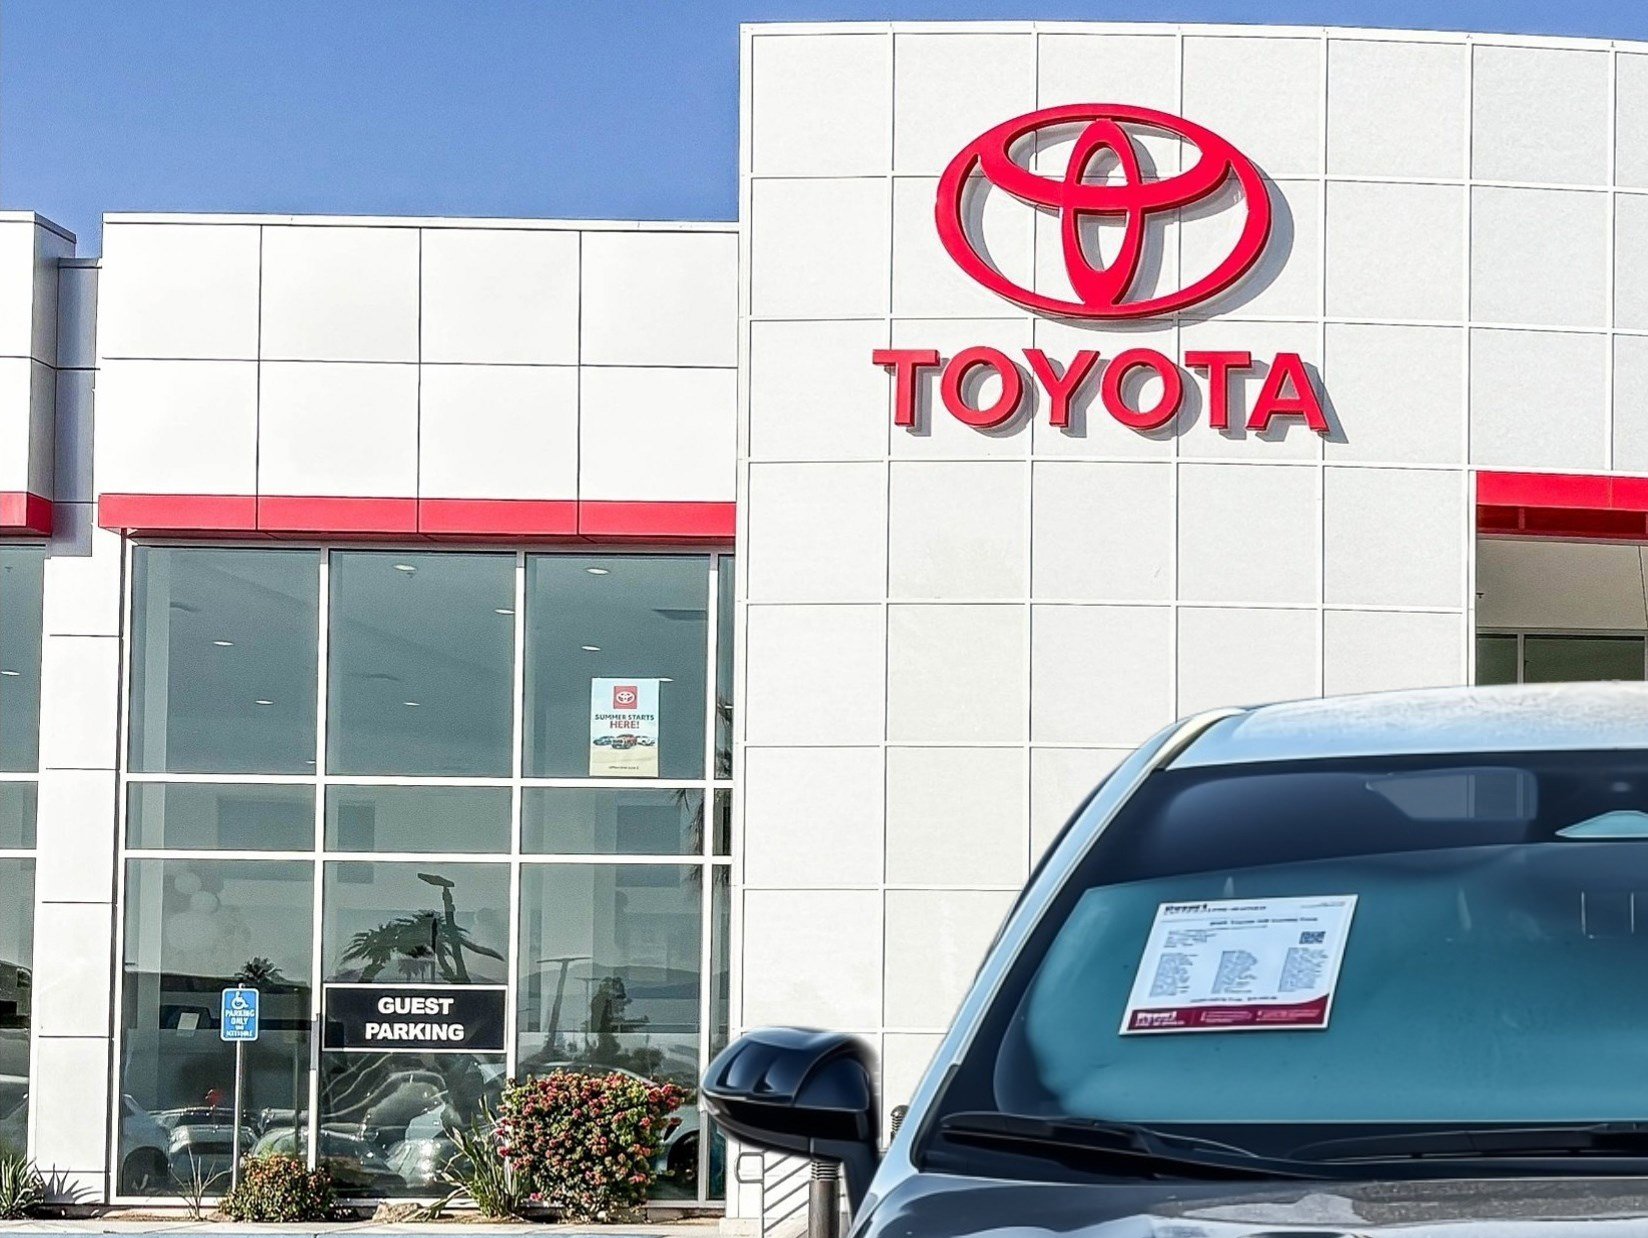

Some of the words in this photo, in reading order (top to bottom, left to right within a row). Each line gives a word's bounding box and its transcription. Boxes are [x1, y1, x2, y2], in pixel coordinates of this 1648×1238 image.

[872, 345, 1329, 433] TOYOTA
[610, 721, 640, 729] HERE!
[377, 996, 455, 1015] GUEST
[225, 1009, 255, 1018] PARKING
[230, 1017, 249, 1025] ONLY
[365, 1022, 465, 1041] PARKING
